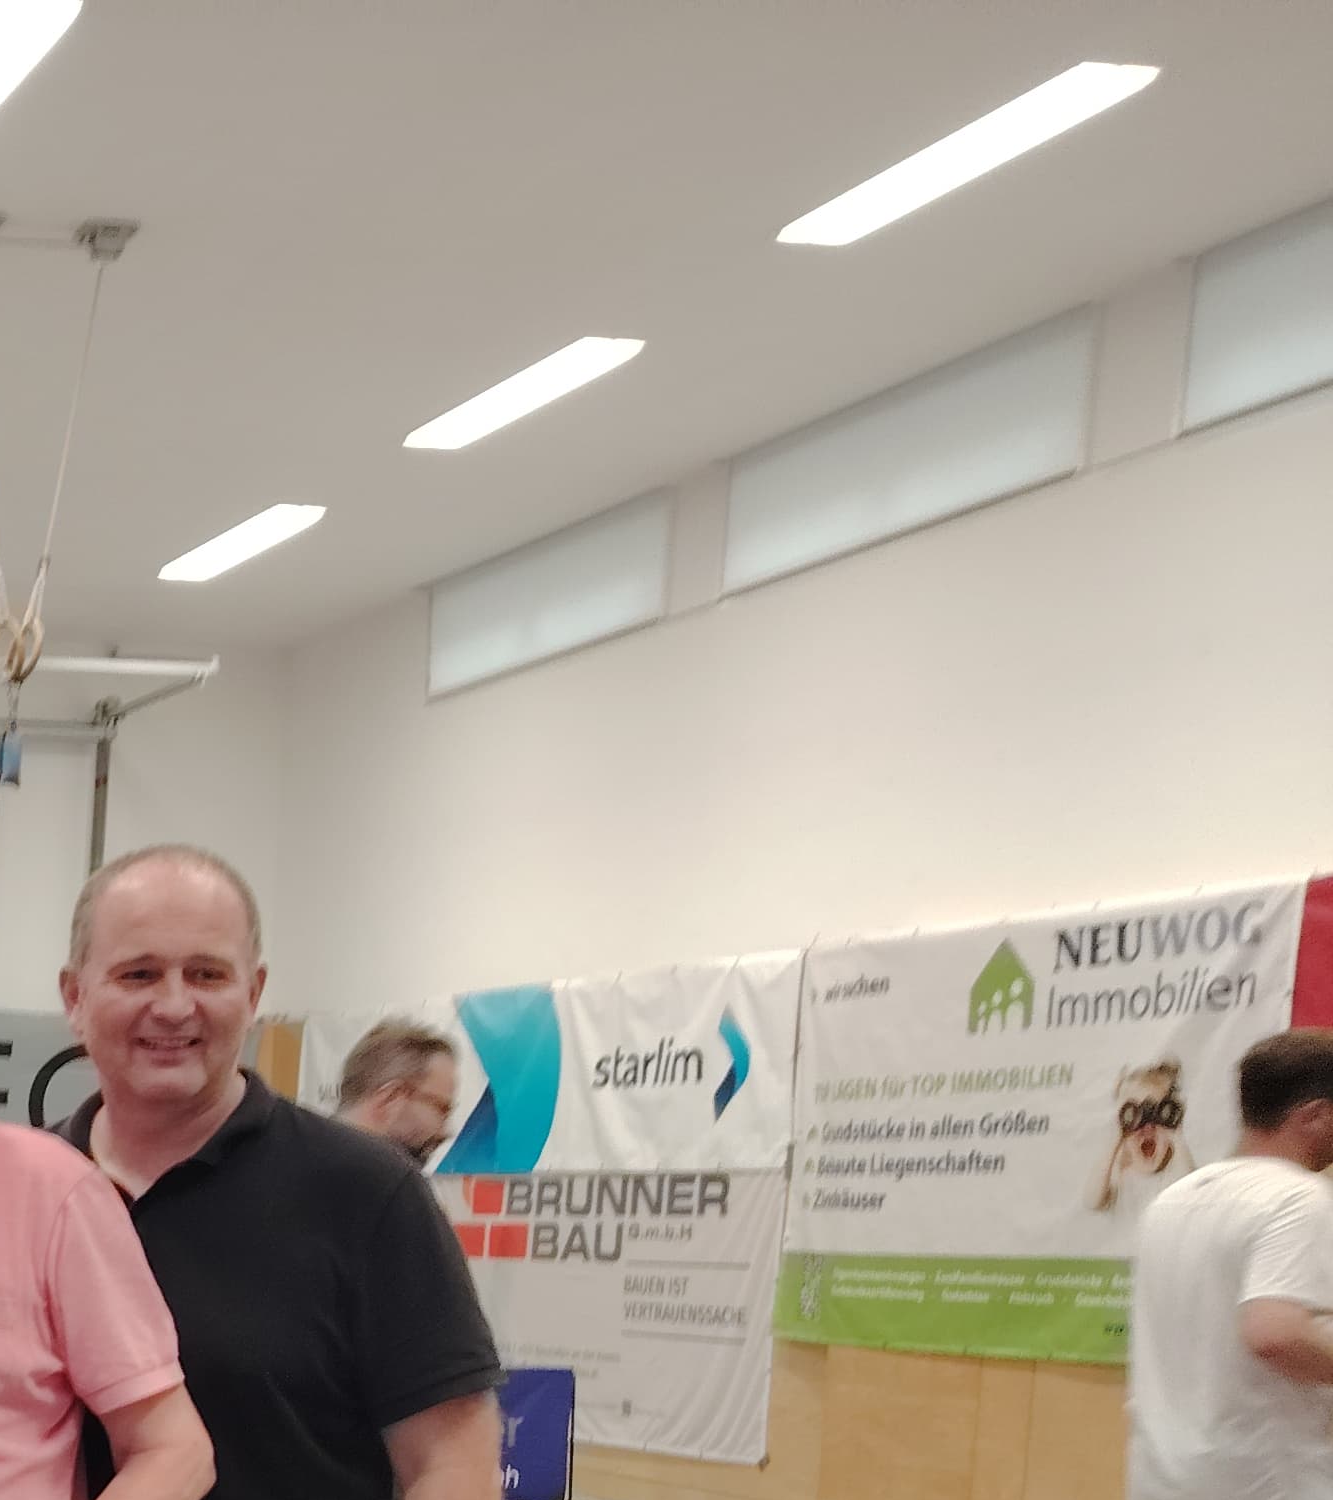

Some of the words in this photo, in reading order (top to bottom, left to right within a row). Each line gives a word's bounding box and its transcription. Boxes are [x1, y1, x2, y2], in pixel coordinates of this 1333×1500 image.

[1045, 965, 1259, 1030] Immobilien
[592, 1037, 705, 1089] starlim
[910, 1071, 947, 1098] TOP
[950, 1063, 1076, 1096] IMMOBILIEN
[909, 1116, 927, 1140] in
[930, 1113, 974, 1141] allen
[978, 1108, 1051, 1139] Größen
[869, 1149, 1006, 1182] Liegenschaften
[504, 1172, 731, 1218] BRUNNER
[530, 1221, 625, 1263] BAU
[622, 1275, 666, 1294] BAUEN
[669, 1276, 691, 1297] IST
[623, 1302, 749, 1329] VERTRAUENSSACHE
